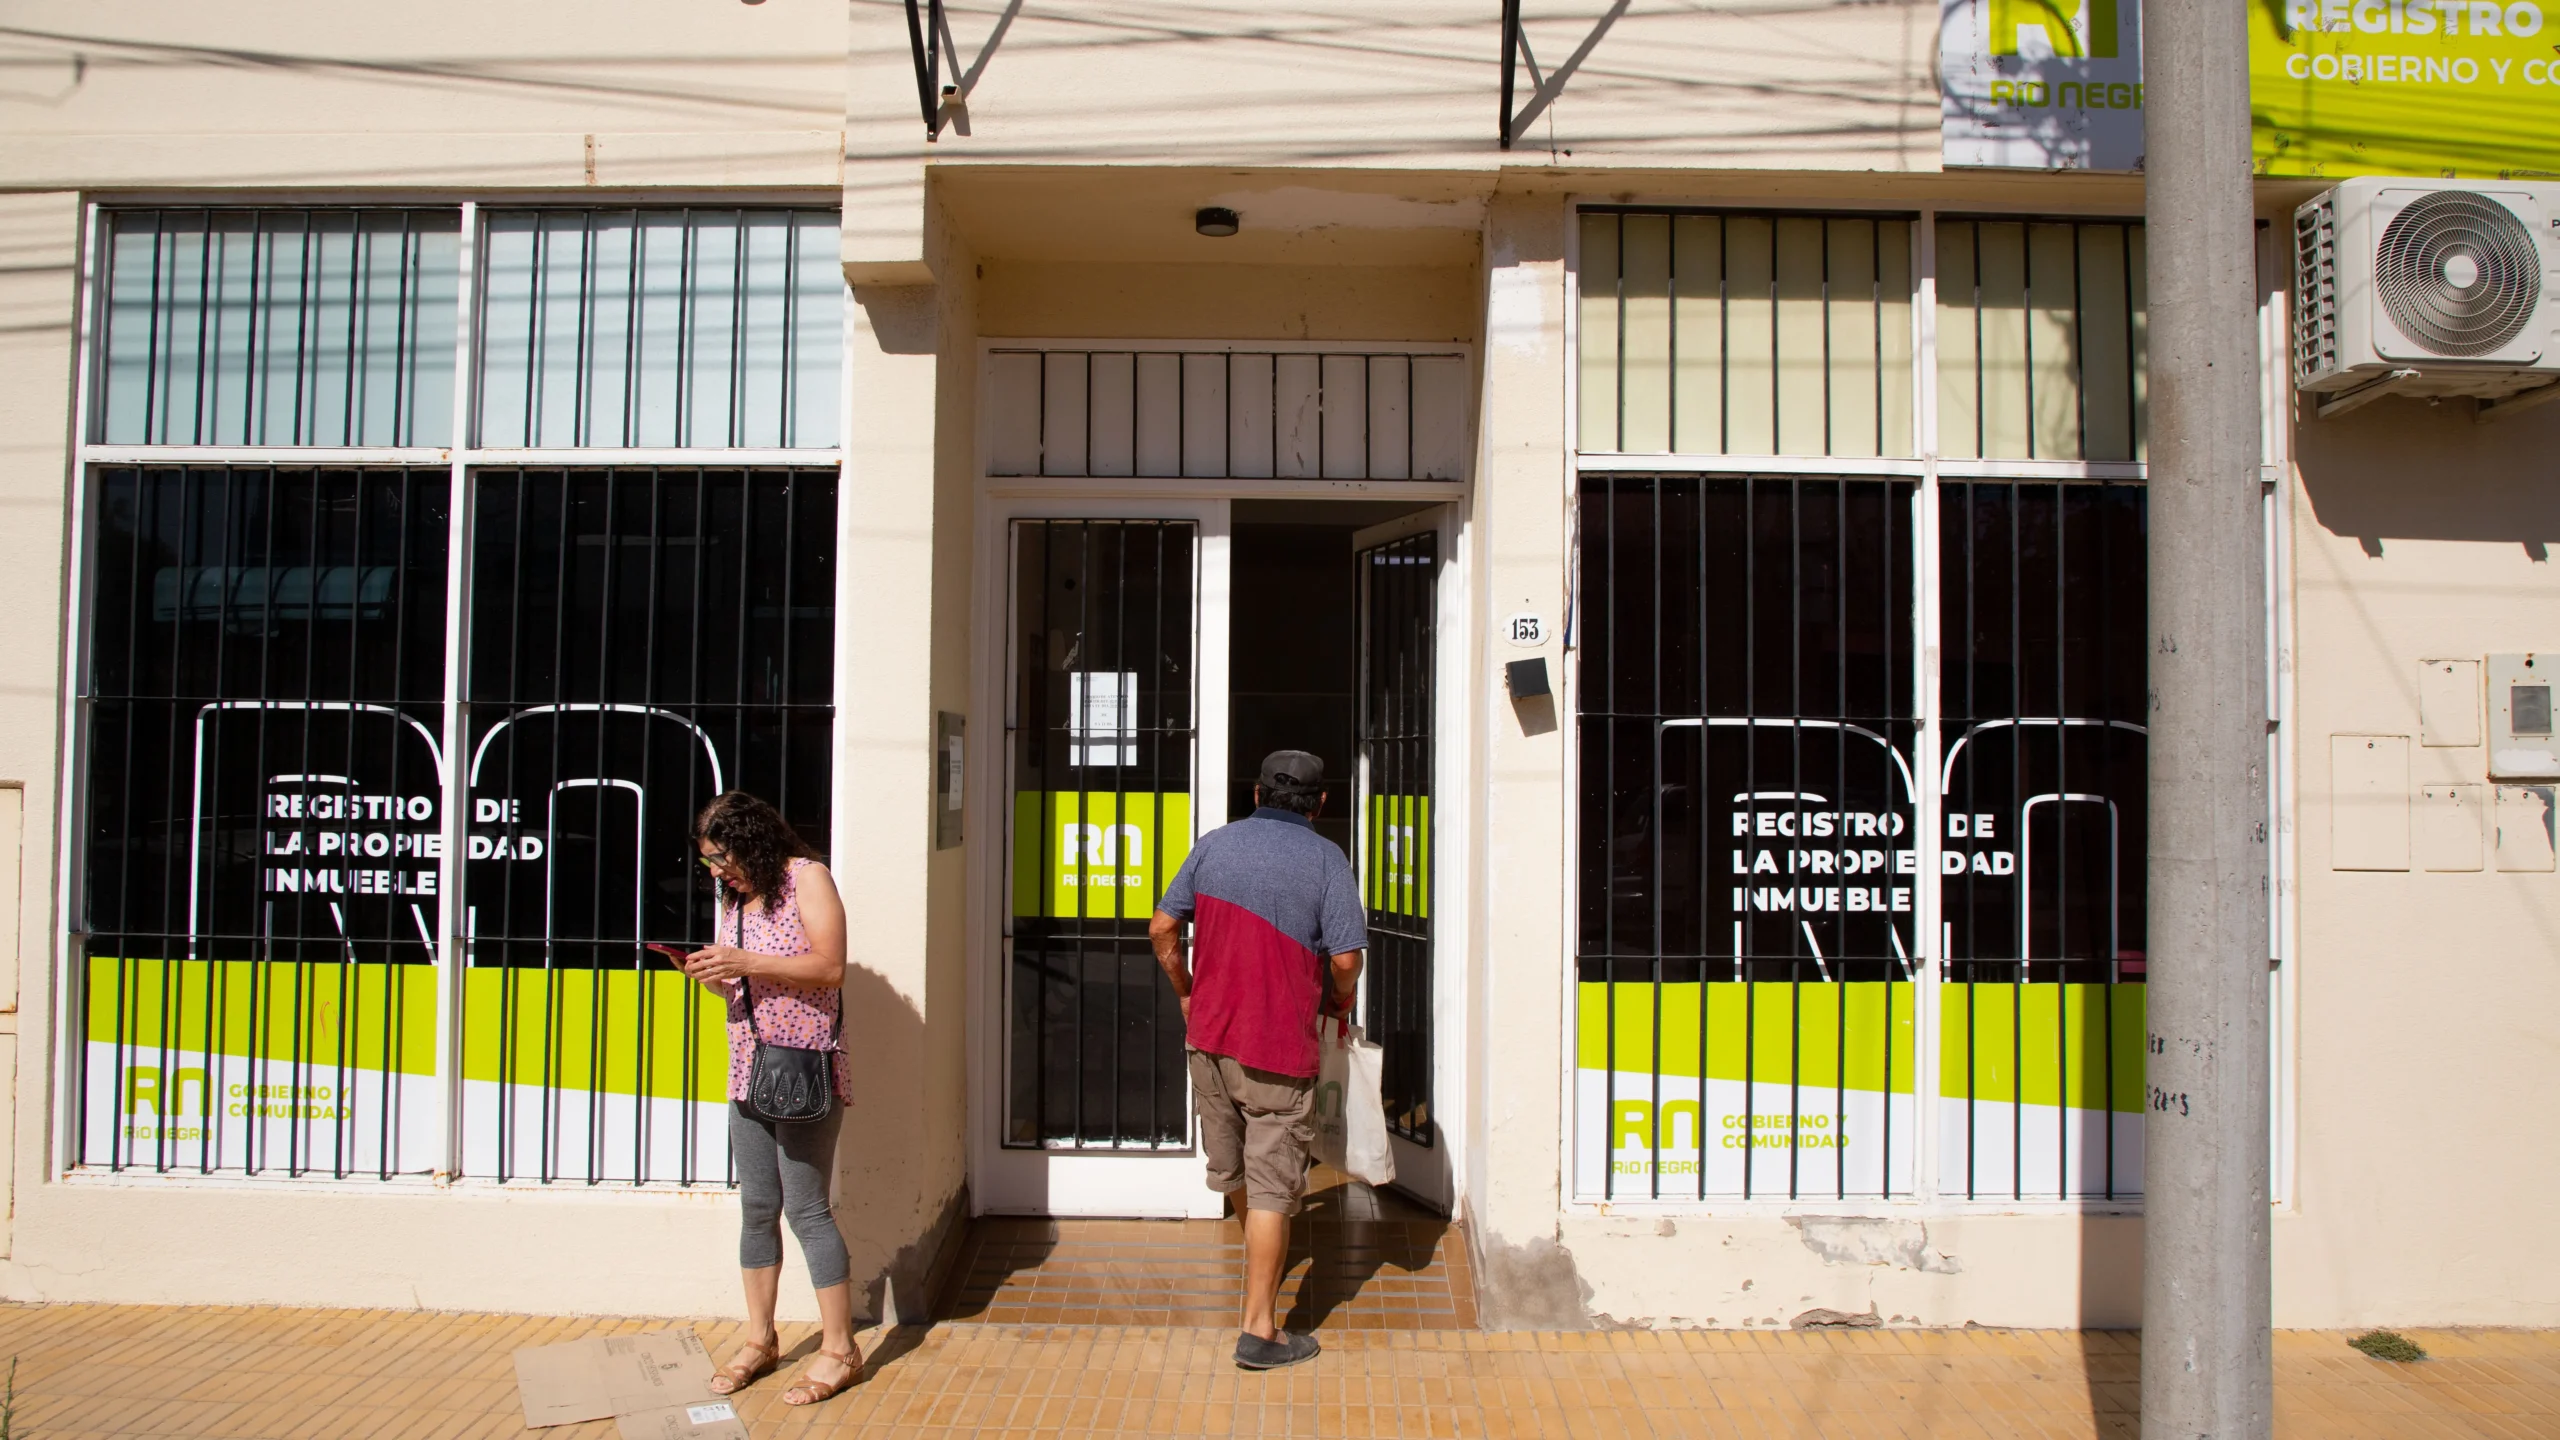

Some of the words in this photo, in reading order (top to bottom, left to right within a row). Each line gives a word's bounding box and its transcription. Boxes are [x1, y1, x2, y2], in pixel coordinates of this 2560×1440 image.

[2286, 0, 2543, 37] REGISTRO
[2286, 54, 2479, 84] GOBIERNO
[2490, 58, 2512, 84] Y
[2058, 81, 2143, 109] NEG
[1512, 618, 1539, 640] 153
[267, 794, 433, 820] REGISTRO
[475, 799, 521, 823] DE
[1732, 812, 1905, 837] REGISTRO
[1948, 814, 1995, 838] DE
[266, 831, 311, 855] LA
[1732, 850, 1779, 874] LA
[265, 868, 437, 895] INMUEBLE
[1733, 887, 1911, 912] INMUEBLE
[229, 1083, 331, 1100] GOBIERNO
[228, 1103, 352, 1120] COMUNIDAD
[1722, 1114, 1829, 1129] GOBIERNO
[1722, 1134, 1850, 1149] COMUNIDAD
